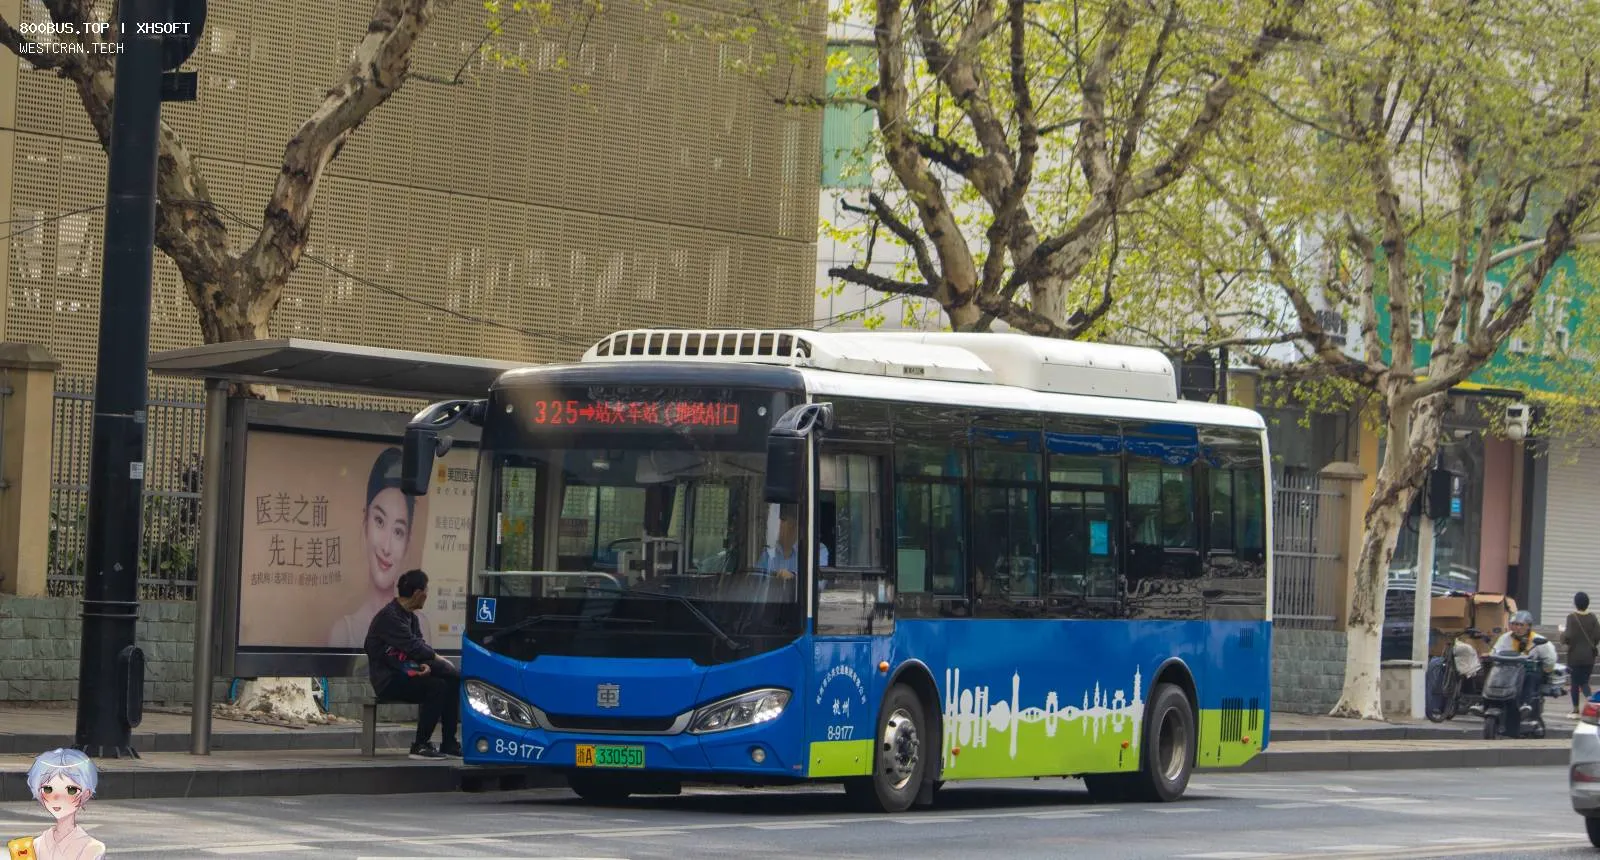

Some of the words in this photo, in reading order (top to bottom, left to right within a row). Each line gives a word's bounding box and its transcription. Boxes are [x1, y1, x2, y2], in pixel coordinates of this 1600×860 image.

[535, 401, 578, 424] 325
[256, 492, 328, 527] 医美之前
[268, 534, 342, 568] 先上美团
[827, 725, 854, 740] 8-9177
[495, 738, 545, 760] 8-9177
